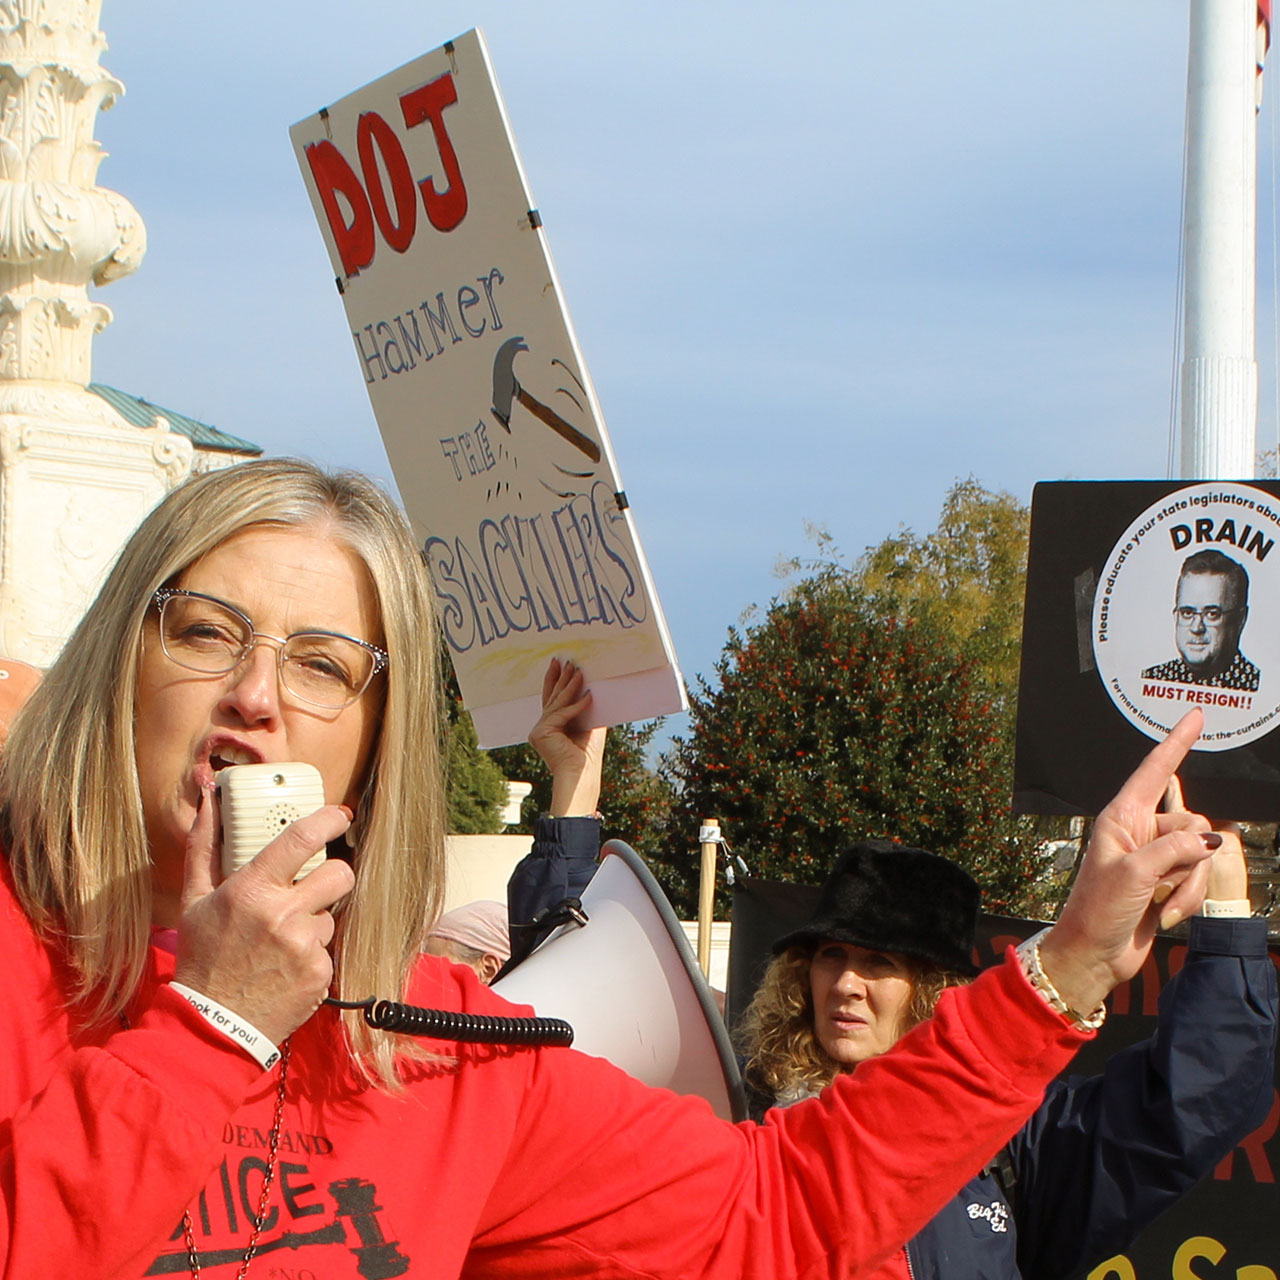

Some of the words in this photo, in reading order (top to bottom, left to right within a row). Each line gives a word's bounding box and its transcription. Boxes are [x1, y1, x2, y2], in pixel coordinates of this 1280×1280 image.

[304, 70, 468, 278] DOJ
[440, 420, 497, 482] THE
[1169, 518, 1274, 562] DRAIN
[421, 480, 649, 654] SACKLERS
[1098, 596, 1110, 643] Please
[1105, 542, 1133, 595] educate
[1130, 517, 1156, 546] your
[1157, 498, 1187, 521] state
[1189, 492, 1255, 509] legislators
[1111, 677, 1122, 694] For
[1120, 694, 1138, 714] more
[1137, 711, 1171, 734] informa
[1142, 684, 1184, 701] MUST
[1186, 690, 1253, 710] RESIGN!!
[212, 1011, 231, 1027] for
[222, 1122, 334, 1155] DEMAND
[967, 1203, 993, 1221] Big
